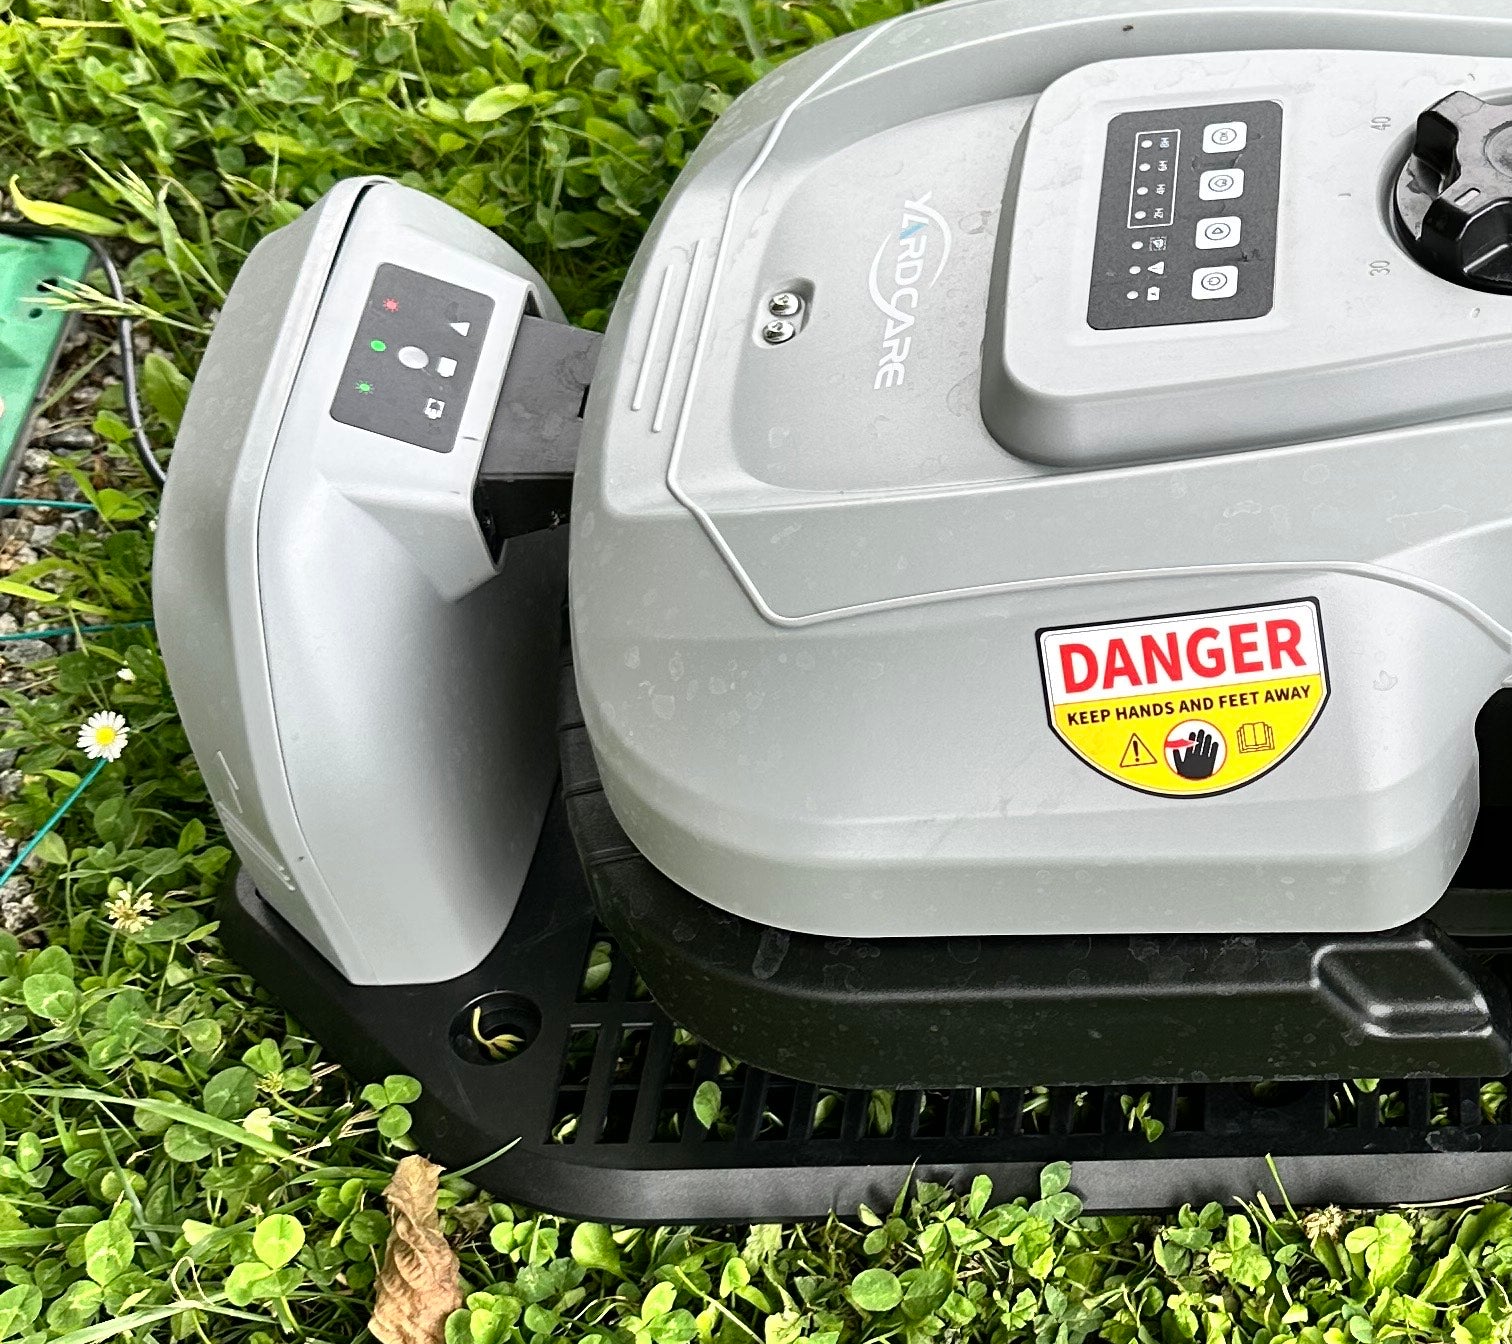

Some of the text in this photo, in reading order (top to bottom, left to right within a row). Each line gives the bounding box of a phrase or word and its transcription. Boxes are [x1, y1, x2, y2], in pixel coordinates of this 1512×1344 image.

[1370, 116, 1391, 131] 40
[1369, 260, 1390, 276] 30
[1058, 618, 1308, 694] DANGER
[1067, 684, 1311, 727] KEEP HANDS AND FEET AWAY
